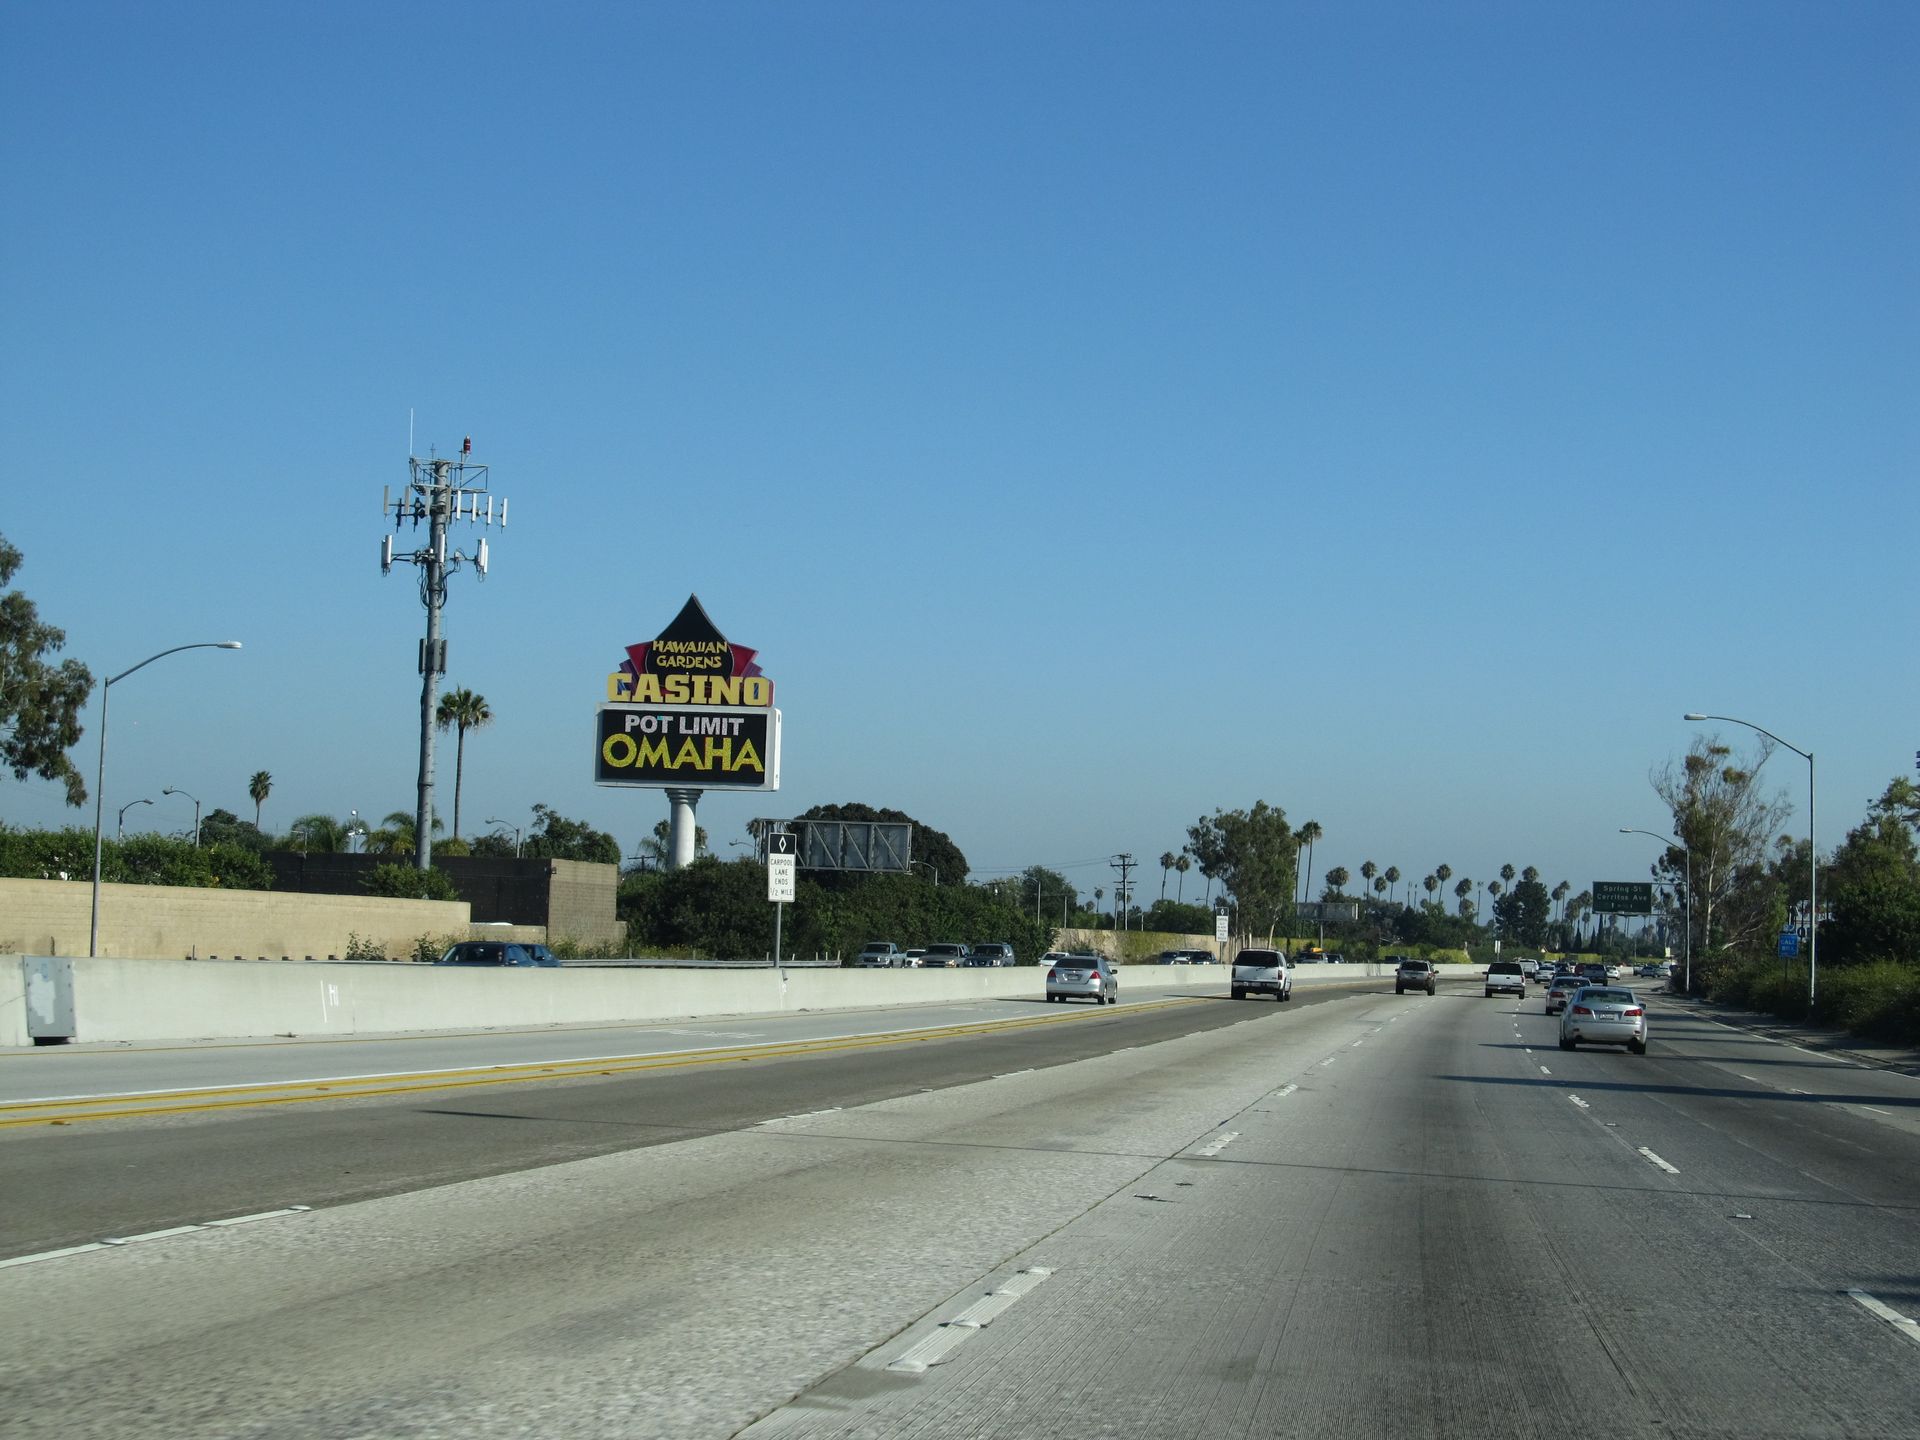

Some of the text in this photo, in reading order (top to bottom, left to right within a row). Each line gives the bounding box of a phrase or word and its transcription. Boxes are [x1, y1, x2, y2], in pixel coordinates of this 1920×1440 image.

[653, 640, 727, 653] HAWAIIAN
[656, 655, 722, 669] GARDENS
[607, 673, 769, 705] CASINO
[625, 714, 744, 736] POT LIMIT
[602, 734, 764, 771] OMAHA
[774, 868, 788, 876] LANE
[1603, 885, 1629, 893] Spring
